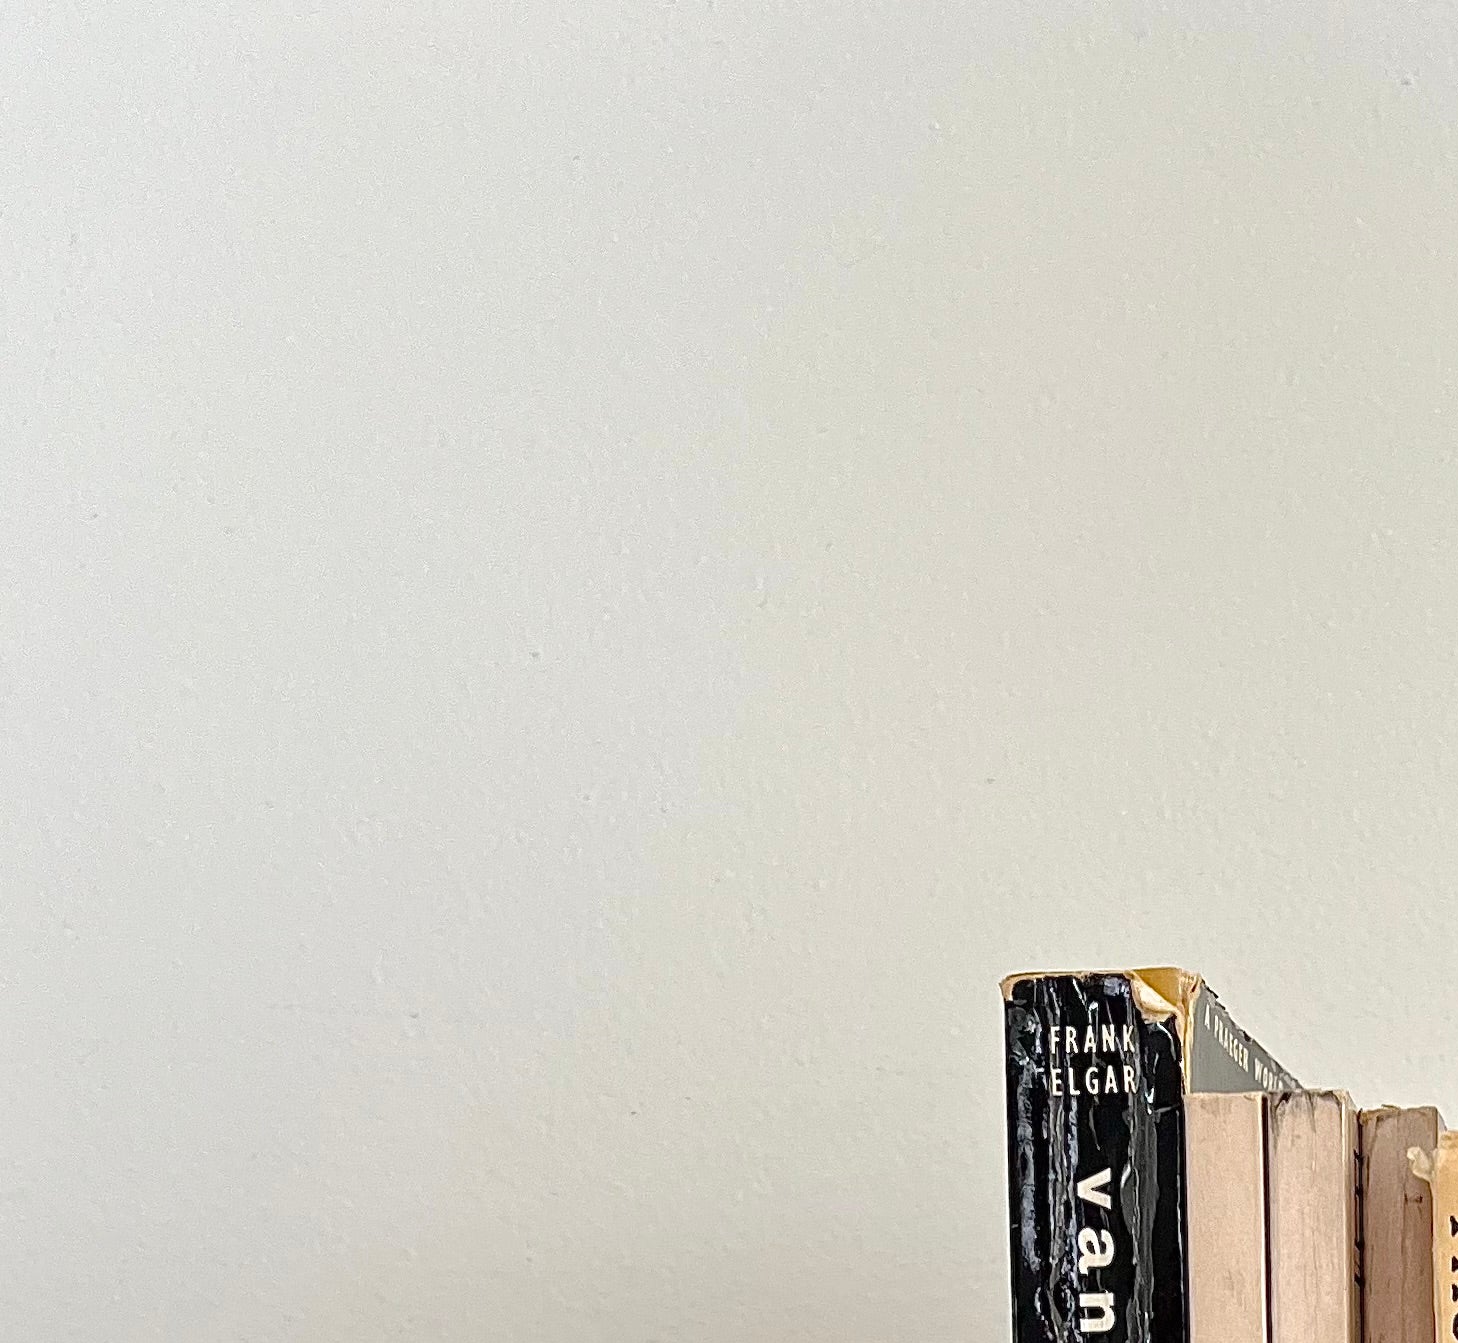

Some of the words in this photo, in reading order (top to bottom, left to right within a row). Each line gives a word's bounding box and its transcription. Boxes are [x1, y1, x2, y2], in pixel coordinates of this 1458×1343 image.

[1050, 1024, 1135, 1053] FRANK
[1214, 1014, 1248, 1073] PRAEGER
[1051, 1065, 1137, 1097] ELGAR
[1077, 1167, 1115, 1334] van
